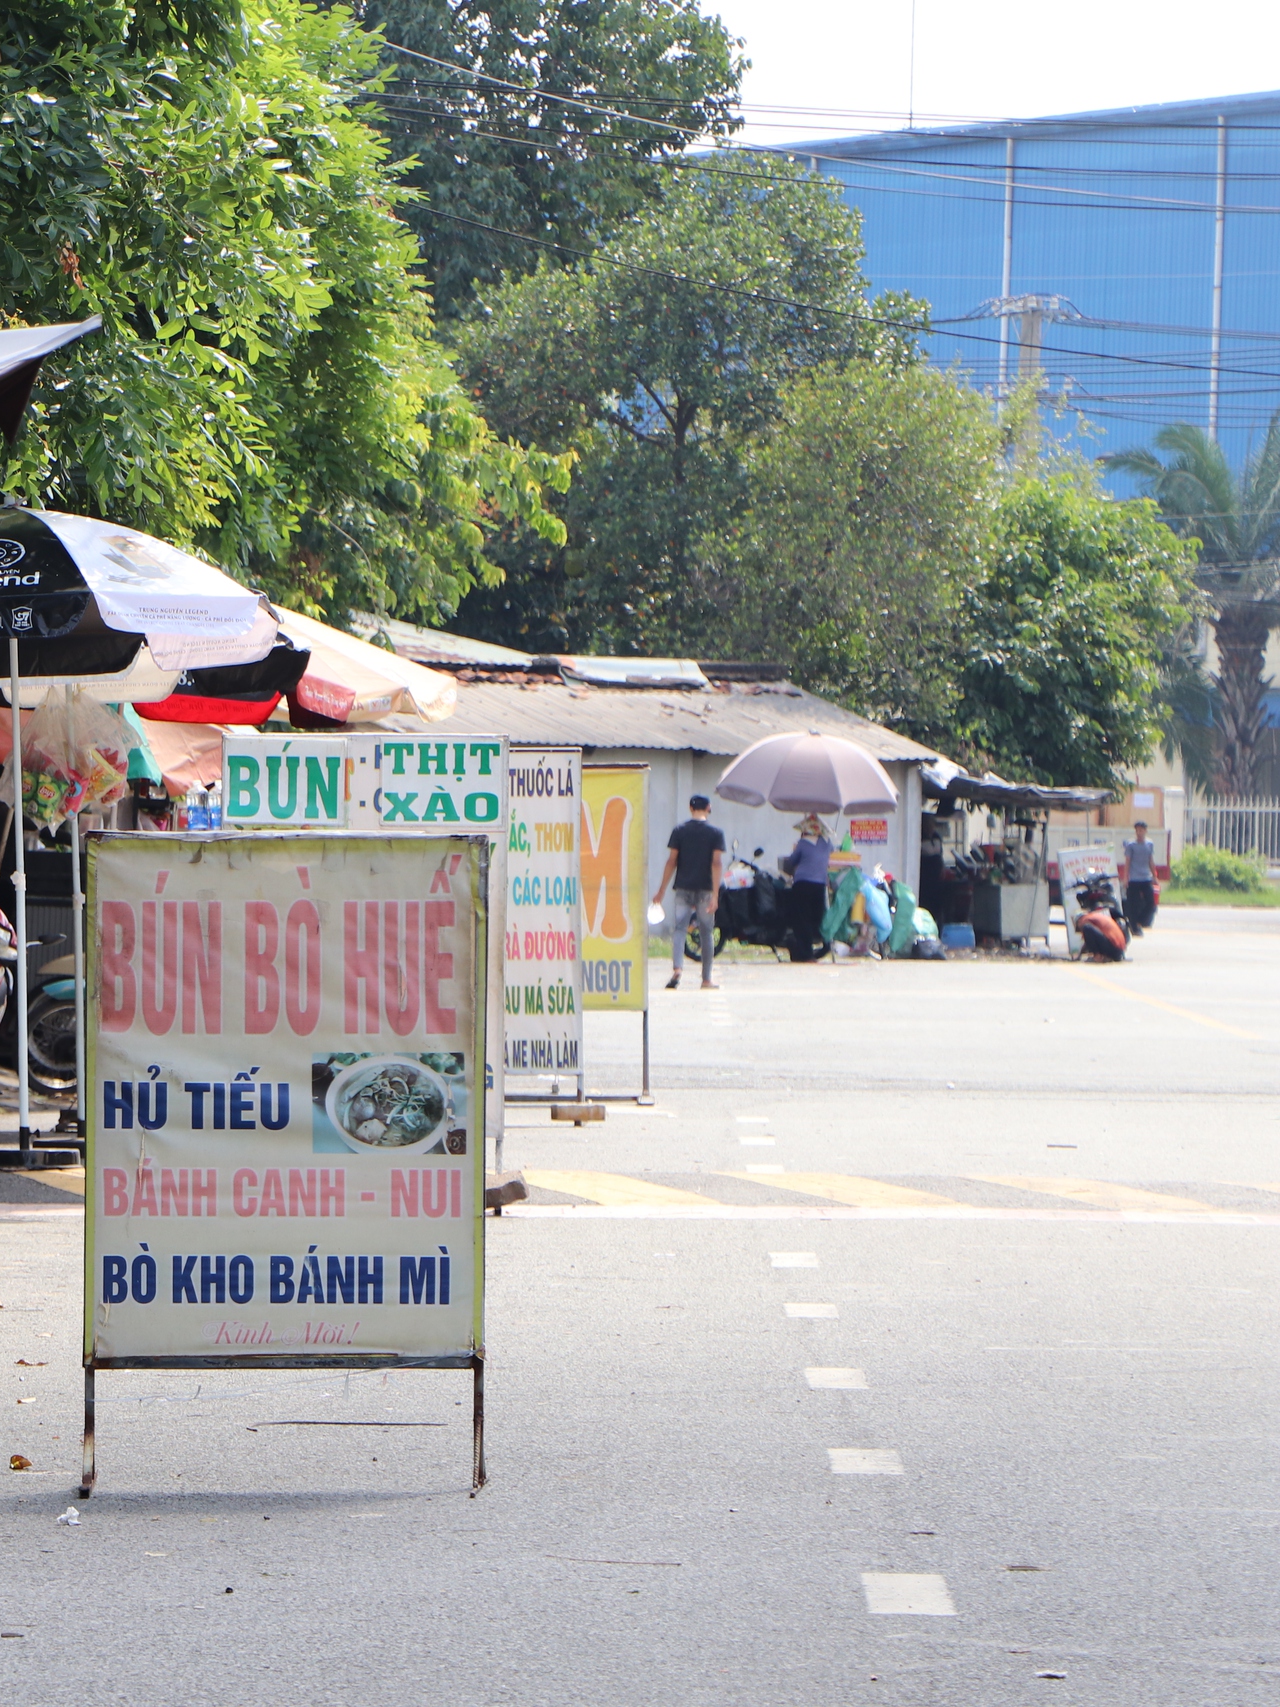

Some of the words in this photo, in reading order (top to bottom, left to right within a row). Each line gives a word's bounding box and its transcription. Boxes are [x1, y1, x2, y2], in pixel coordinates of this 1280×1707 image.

[226, 741, 341, 819] BÚN
[383, 742, 500, 783] THỊT
[509, 756, 554, 797] THUỐC
[558, 760, 574, 797] LÁ
[383, 785, 499, 822] XÀO
[512, 868, 541, 906] CÁC
[545, 876, 577, 914] LOẠI
[101, 870, 221, 1037] BÚN
[244, 866, 321, 1037] BÒ
[344, 854, 463, 1037] HUẾ
[524, 923, 577, 961] ĐƯỜNG
[524, 977, 544, 1015] MÁ
[548, 977, 575, 1015] SỮA
[582, 960, 632, 1000] NGỌT
[513, 1040, 528, 1068] ME
[531, 1032, 553, 1068] NHÀ
[556, 1032, 579, 1068] LÀM
[103, 1065, 168, 1130] HỦ
[184, 1066, 290, 1130] TIẾU
[102, 1158, 217, 1217] BÁNH
[232, 1167, 346, 1217] CANH
[390, 1168, 462, 1218] NUI
[102, 1243, 157, 1304] BÒ
[172, 1255, 255, 1304] KHO
[269, 1245, 384, 1304] BÁNH
[399, 1245, 451, 1305] MÌ
